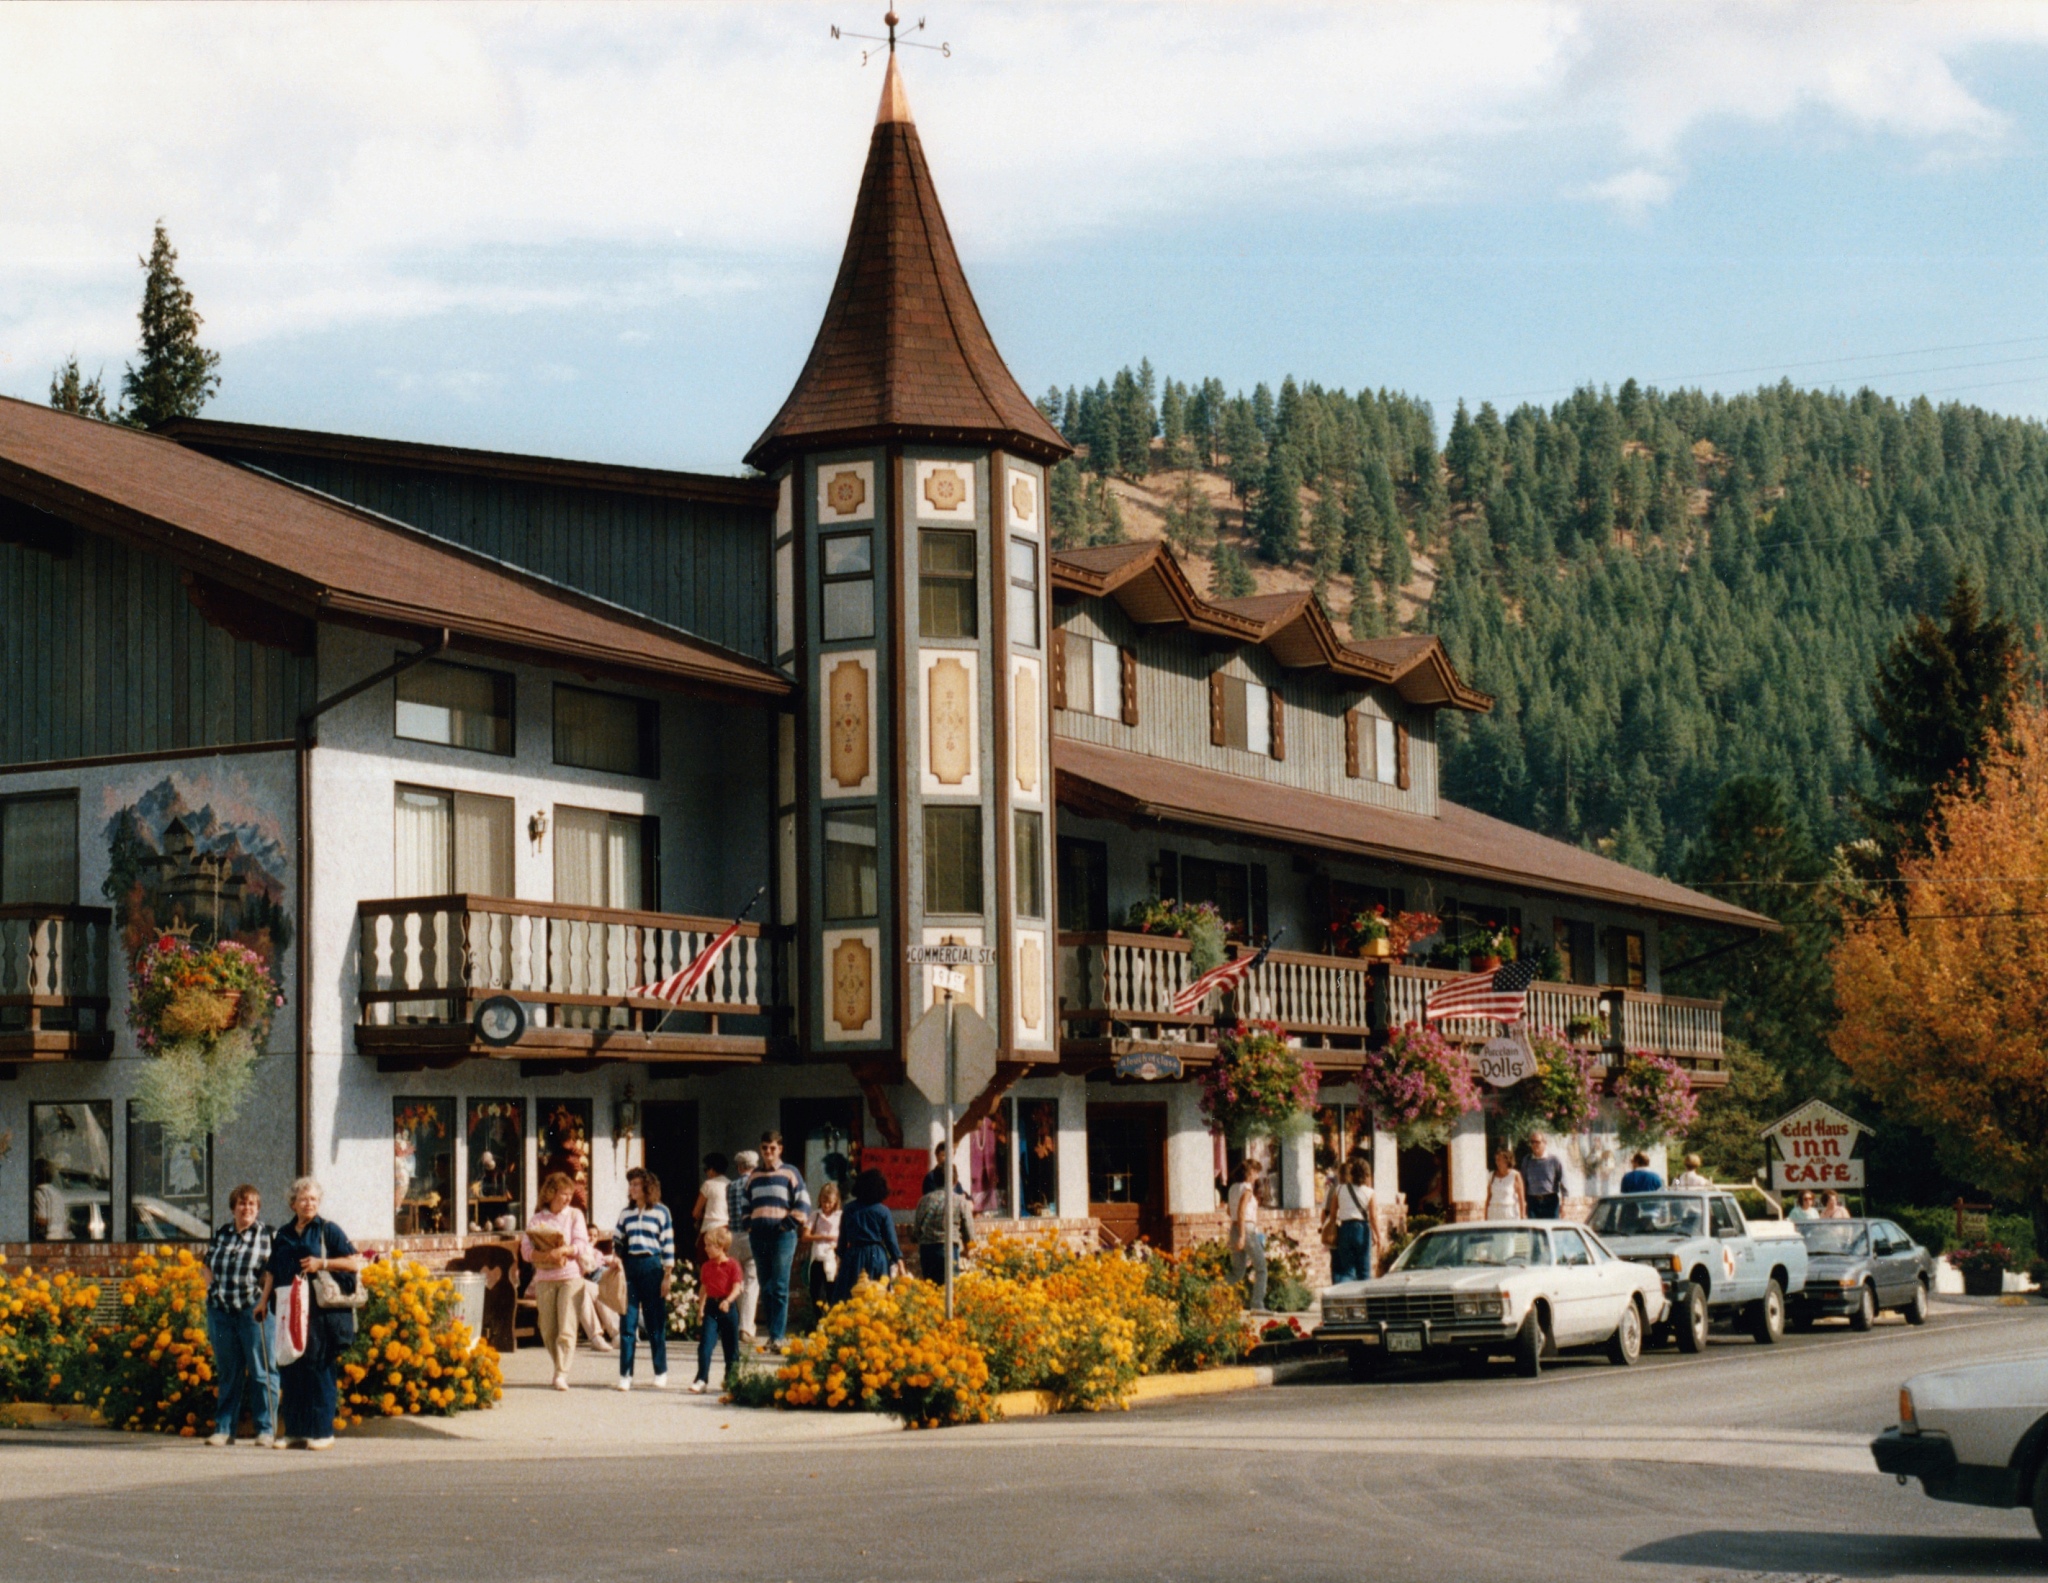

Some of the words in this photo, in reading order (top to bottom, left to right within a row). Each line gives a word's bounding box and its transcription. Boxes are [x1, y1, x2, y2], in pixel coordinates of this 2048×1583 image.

[919, 16, 926, 31] W
[830, 24, 840, 40] N
[942, 42, 951, 58] S
[910, 947, 974, 962] COMMERCIAL
[1484, 1046, 1519, 1056] Porcelain
[1480, 1057, 1525, 1078] Dolls
[1780, 1120, 1812, 1137] Edel
[1814, 1118, 1849, 1136] Haus
[1783, 1163, 1851, 1182] CAFE
